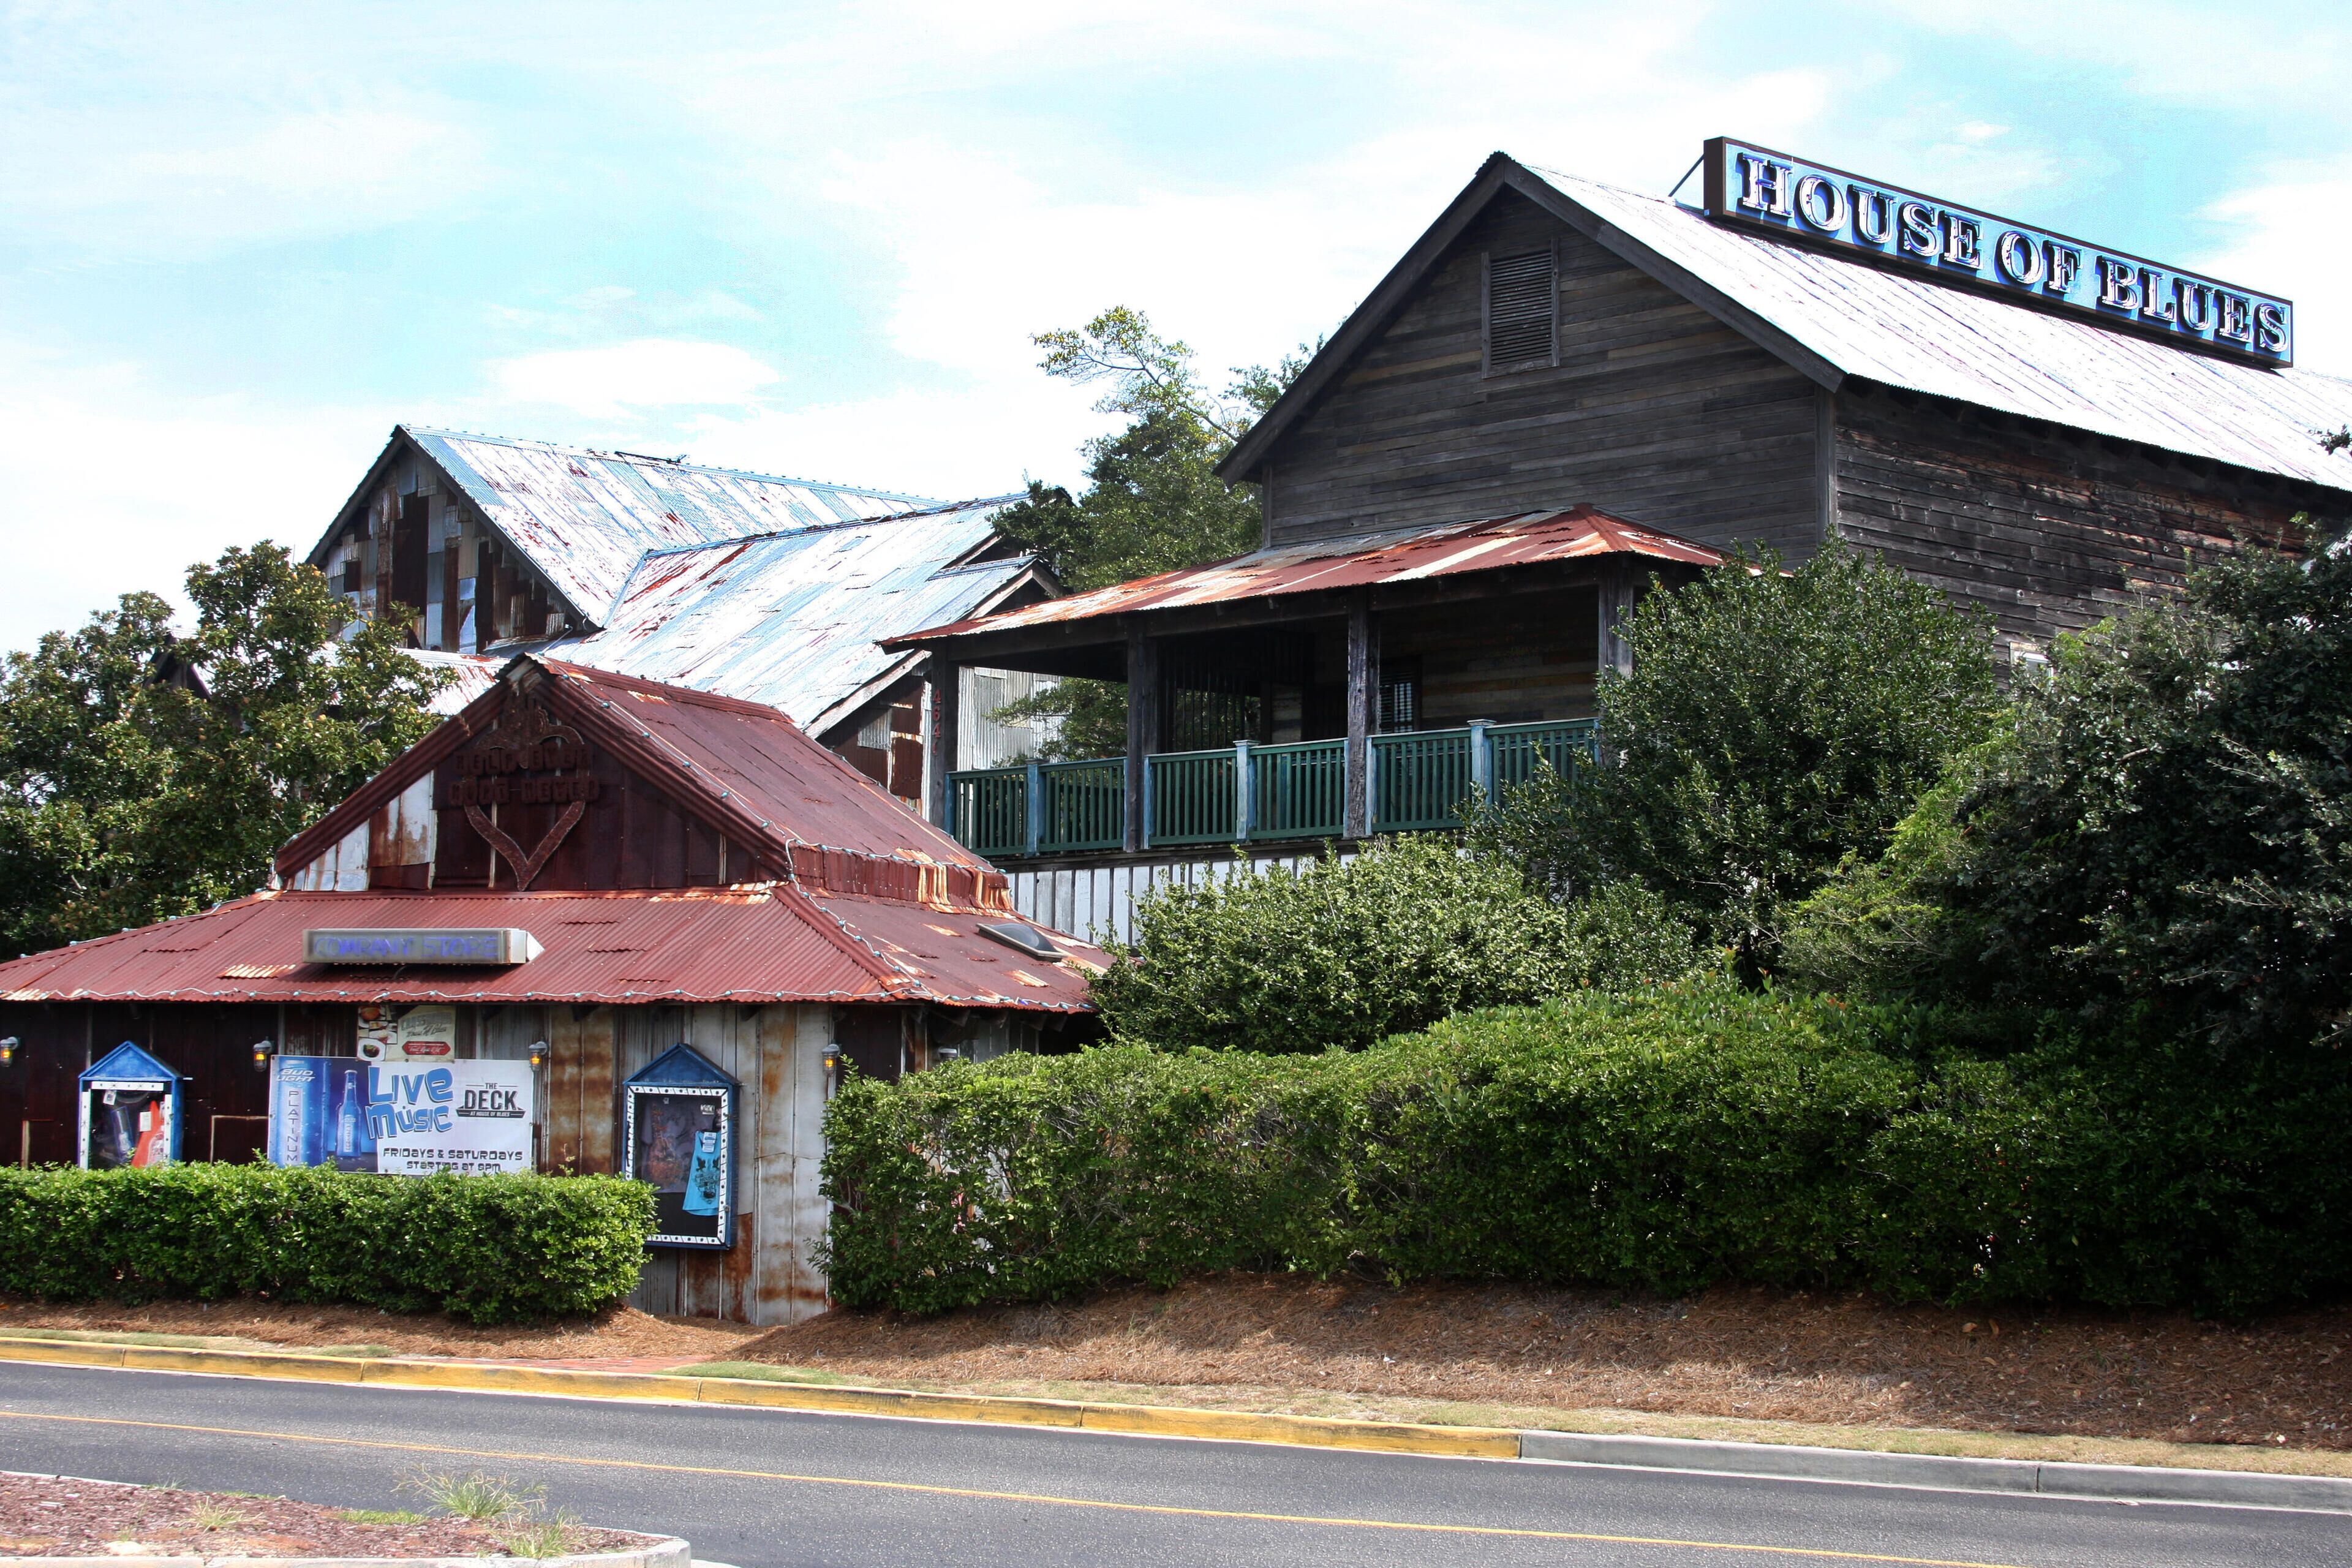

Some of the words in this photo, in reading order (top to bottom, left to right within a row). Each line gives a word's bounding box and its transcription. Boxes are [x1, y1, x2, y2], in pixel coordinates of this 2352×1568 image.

[1740, 152, 1984, 270] HOUSE
[1995, 229, 2081, 294] OF
[2096, 255, 2287, 352] BLUES
[315, 937, 413, 957] COMPANY
[421, 937, 497, 957] STORE
[465, 1090, 517, 1110] DECK
[287, 1091, 299, 1161] PLATINUM
[438, 1150, 444, 1158] &
